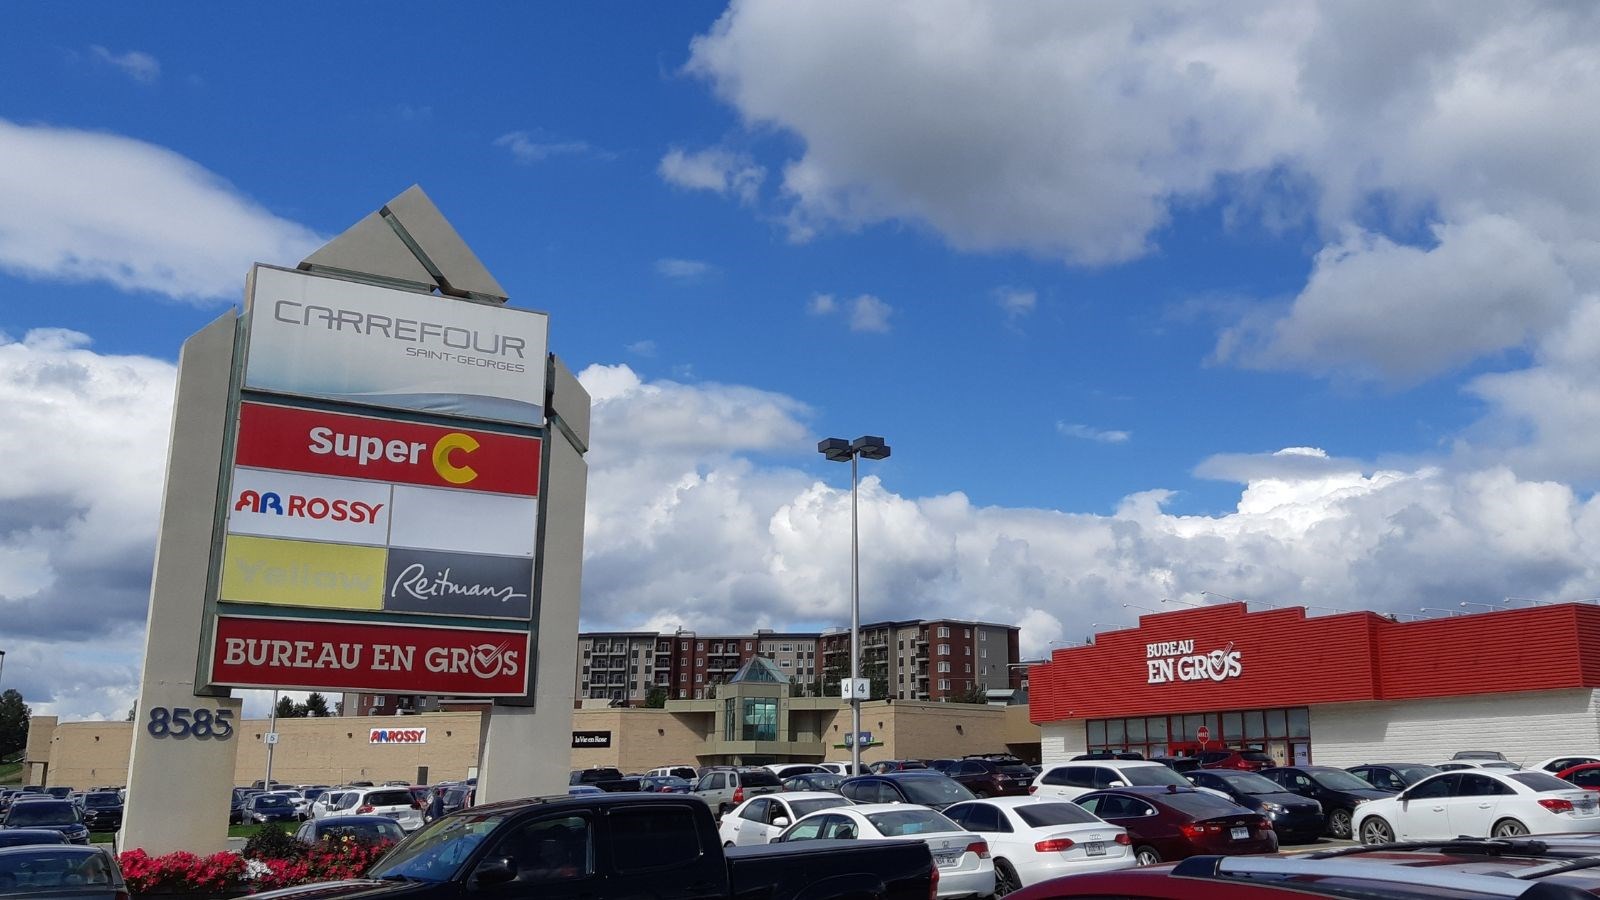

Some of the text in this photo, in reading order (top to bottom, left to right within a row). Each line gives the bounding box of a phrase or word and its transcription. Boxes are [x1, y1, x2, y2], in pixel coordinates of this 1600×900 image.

[274, 300, 525, 359] CARREFOUR
[406, 347, 525, 373] SAINT-GEORGES
[308, 426, 480, 484] Super C
[288, 495, 385, 524] ROSSY
[234, 557, 374, 592] Yellow
[391, 563, 527, 602] Reitmans
[223, 637, 519, 679] BUREAU EN GROS
[1146, 640, 1194, 658] BUREAU
[1147, 642, 1242, 684] EN GROS
[858, 683, 865, 694] 4
[147, 707, 234, 741] 8585
